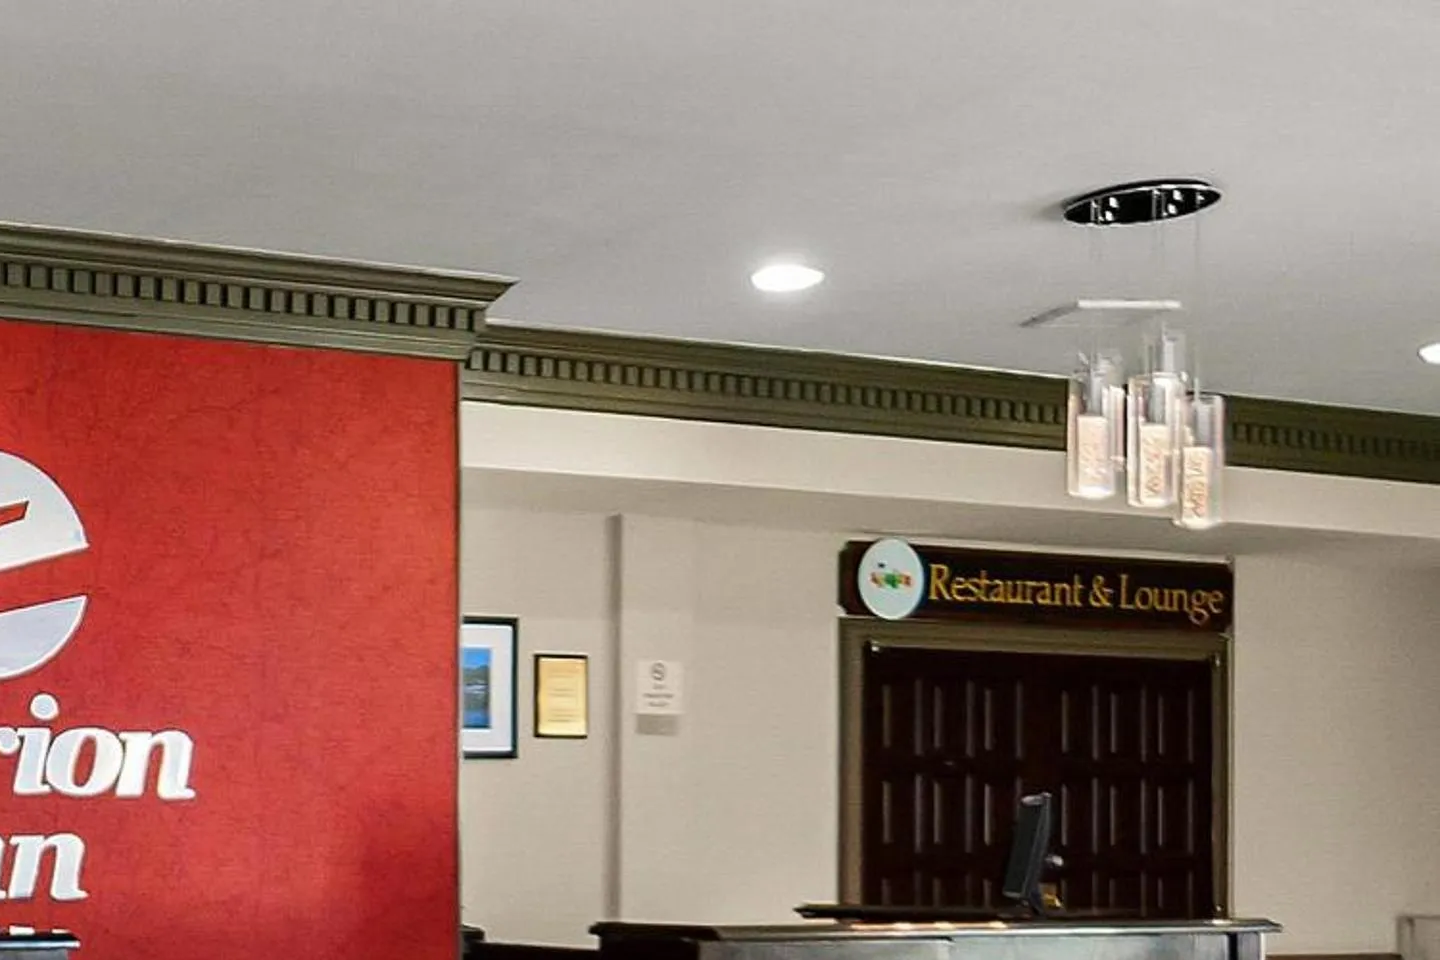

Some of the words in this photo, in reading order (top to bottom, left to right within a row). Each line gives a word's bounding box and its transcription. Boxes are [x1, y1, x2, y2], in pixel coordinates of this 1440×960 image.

[928, 564, 1082, 607] Restaurant
[1088, 576, 1114, 607] &
[1120, 574, 1223, 625] Lounge
